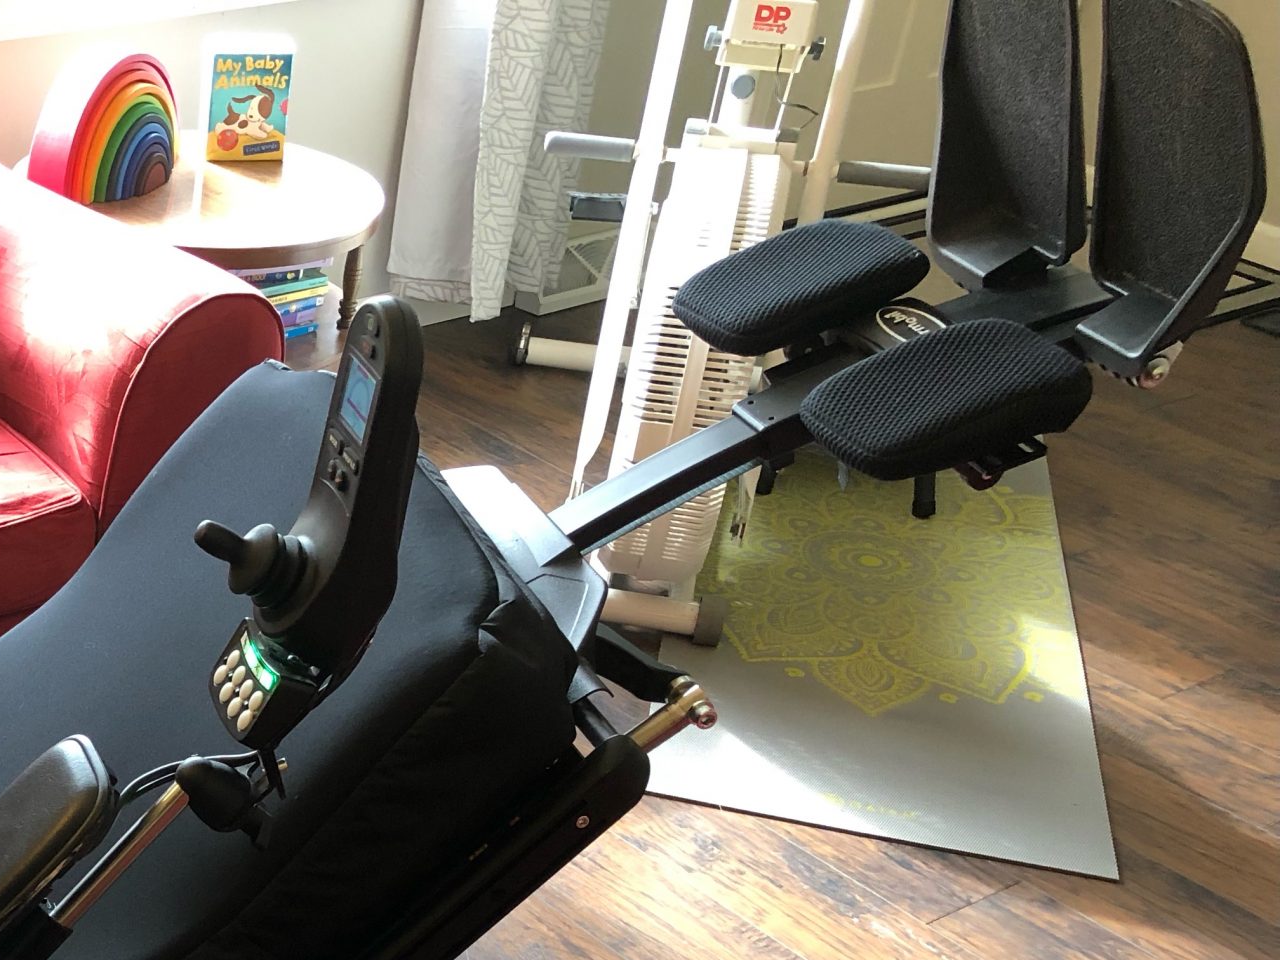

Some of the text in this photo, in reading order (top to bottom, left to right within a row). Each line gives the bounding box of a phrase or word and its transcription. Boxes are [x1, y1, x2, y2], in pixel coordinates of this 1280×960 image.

[754, 4, 791, 23] DP
[216, 55, 284, 75] My Baby
[215, 72, 289, 89] Animals
